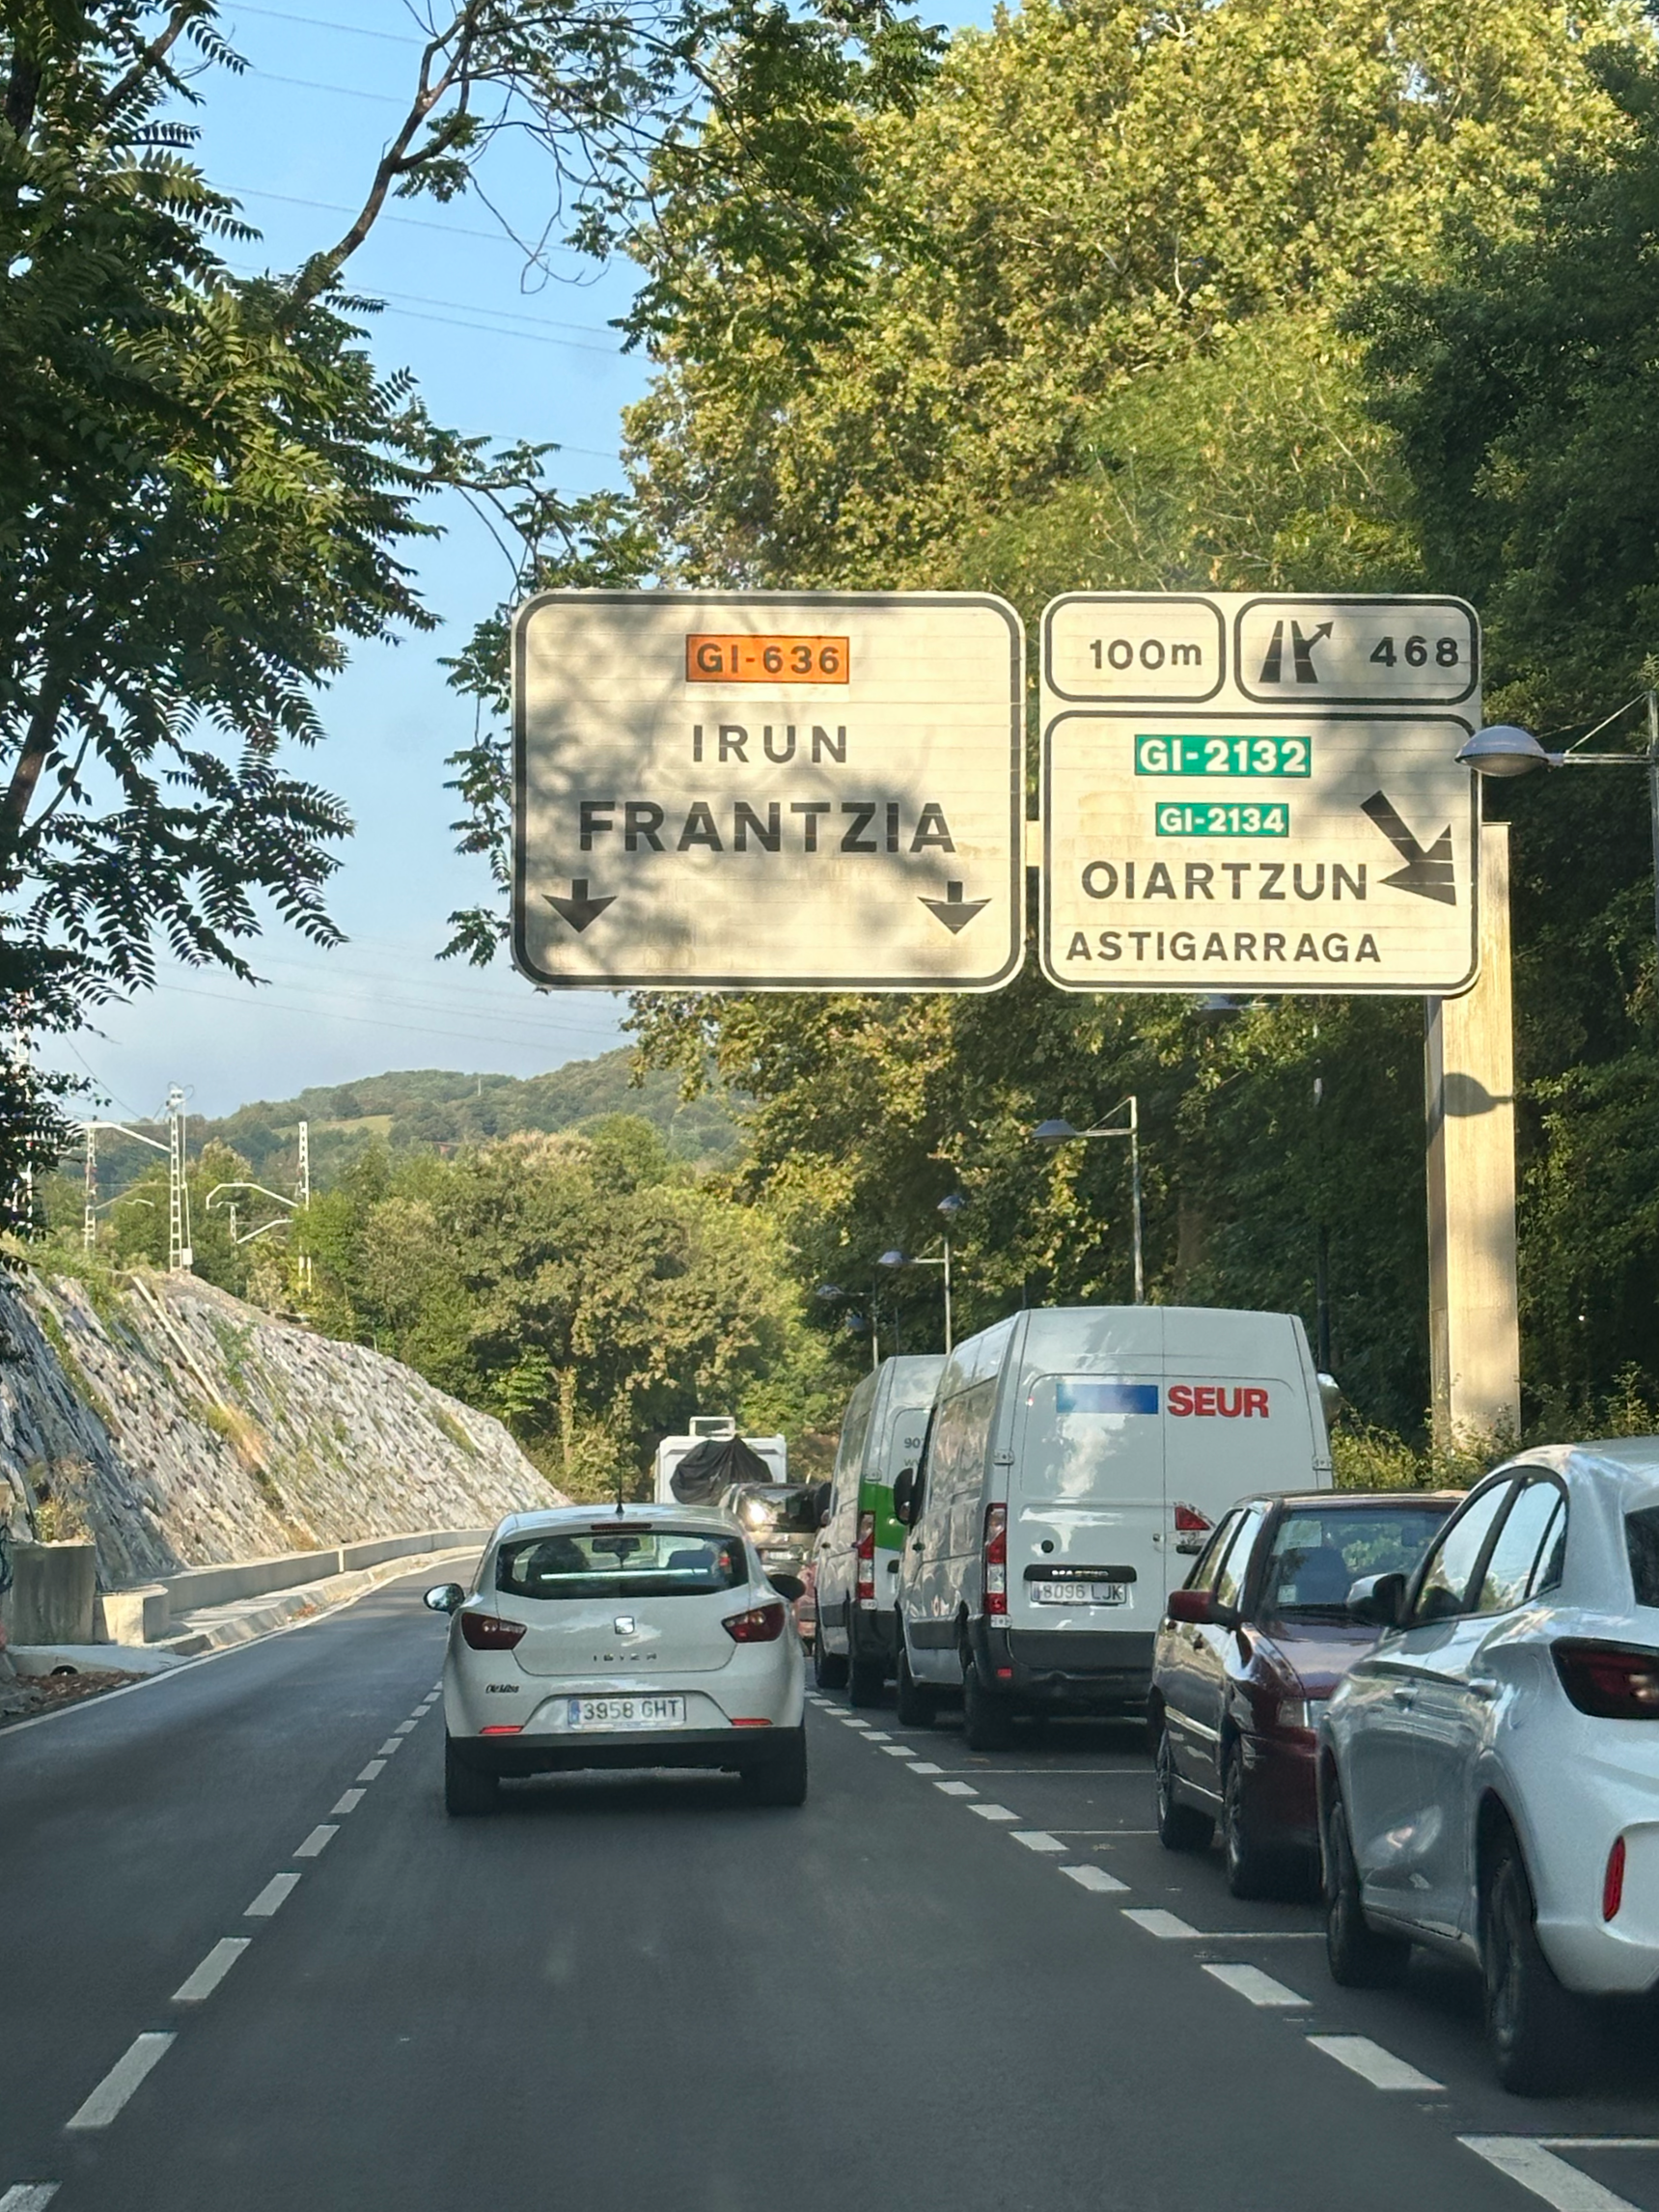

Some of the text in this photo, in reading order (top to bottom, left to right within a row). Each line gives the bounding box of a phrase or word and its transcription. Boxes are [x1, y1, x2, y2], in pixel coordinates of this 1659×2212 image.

[697, 644, 840, 675] GI-636
[1090, 639, 1203, 670] 100m
[1369, 636, 1459, 668] 468
[692, 725, 846, 763] IRUN
[1139, 739, 1307, 773] GI-2132
[579, 801, 956, 853] FRANTZIA
[1160, 809, 1285, 833] GI-2134
[1081, 860, 1367, 900] OIARTZUN
[1066, 930, 1381, 963] ASTIGARRAGA
[1167, 1385, 1269, 1418] SEUR
[1042, 1584, 1122, 1600] 8096 LJK
[583, 1700, 679, 1720] 3958 GHT
